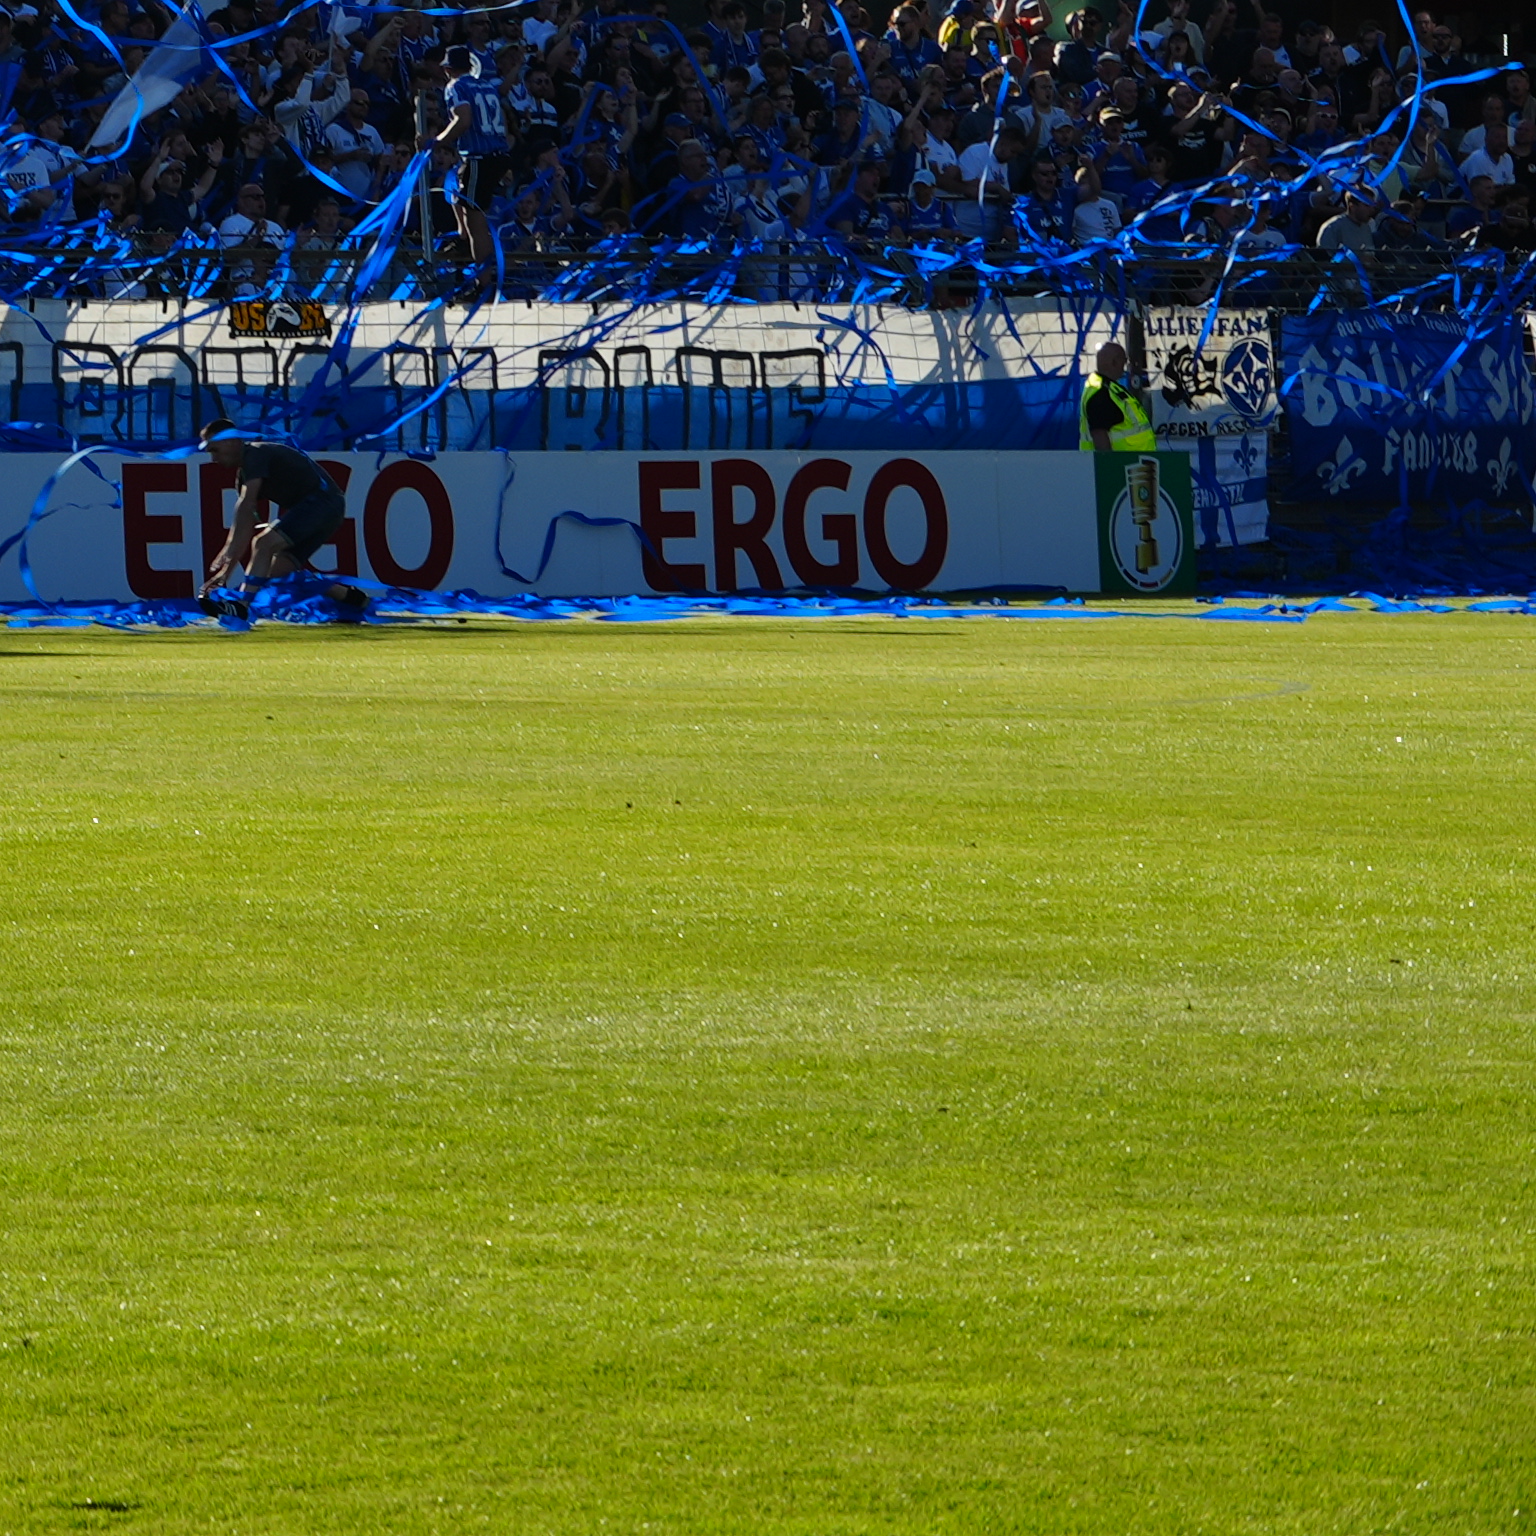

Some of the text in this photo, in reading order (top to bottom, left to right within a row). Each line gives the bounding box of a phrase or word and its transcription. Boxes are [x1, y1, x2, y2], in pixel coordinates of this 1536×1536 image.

[474, 92, 506, 134] 12
[1147, 316, 1270, 338] LILIEFANS
[638, 458, 949, 593] ERGO
